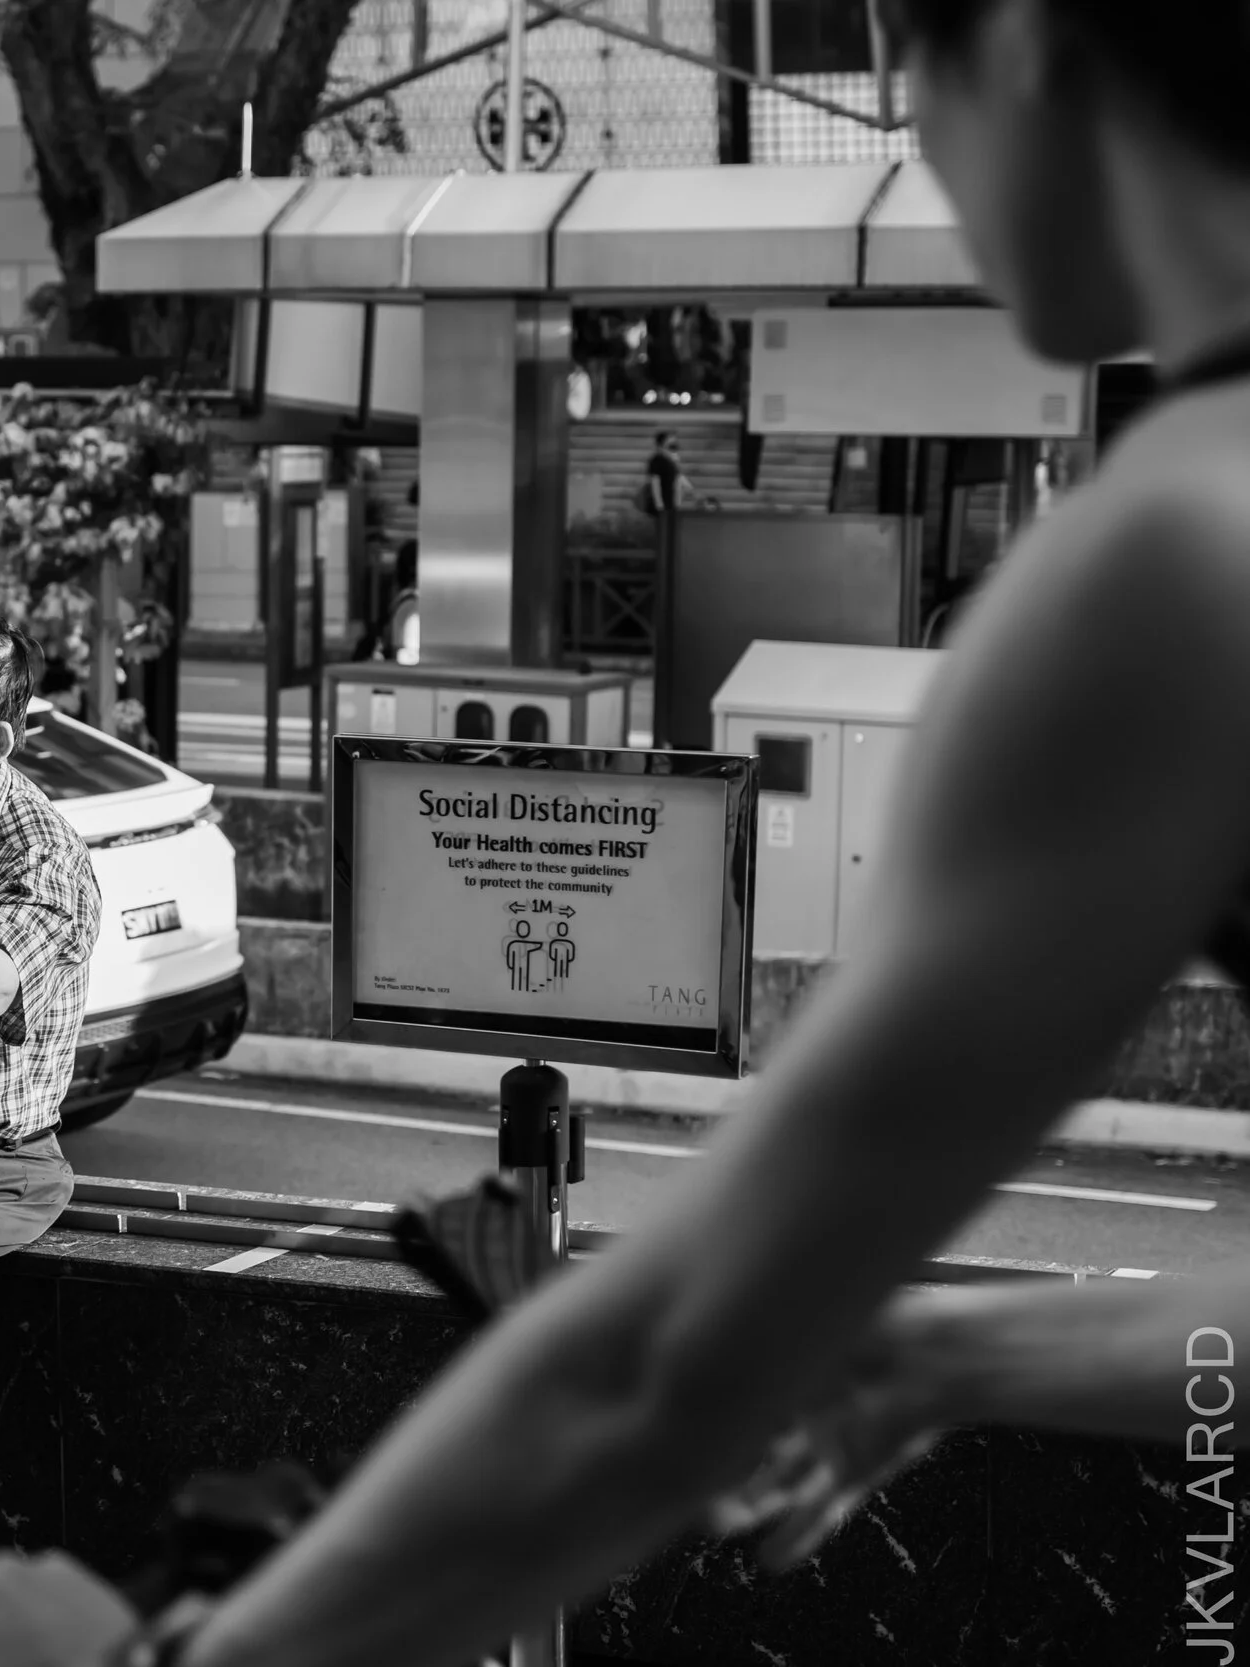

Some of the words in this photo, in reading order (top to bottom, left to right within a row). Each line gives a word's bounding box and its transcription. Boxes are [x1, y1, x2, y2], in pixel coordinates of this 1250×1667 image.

[418, 789, 498, 819] Social
[510, 793, 657, 835] Distancing
[431, 831, 471, 850] Your
[477, 834, 533, 854] Health
[539, 840, 592, 857] comes
[598, 840, 648, 859] FIRST
[448, 857, 474, 870] Let's
[477, 860, 516, 872] adhere
[520, 862, 533, 873] to
[536, 862, 567, 875] these
[570, 864, 630, 878] guidelines
[464, 876, 477, 887] to
[480, 877, 521, 891] protect
[525, 878, 545, 891] the
[548, 881, 613, 897] community
[532, 900, 552, 914] 1M
[648, 985, 706, 1005] TANG
